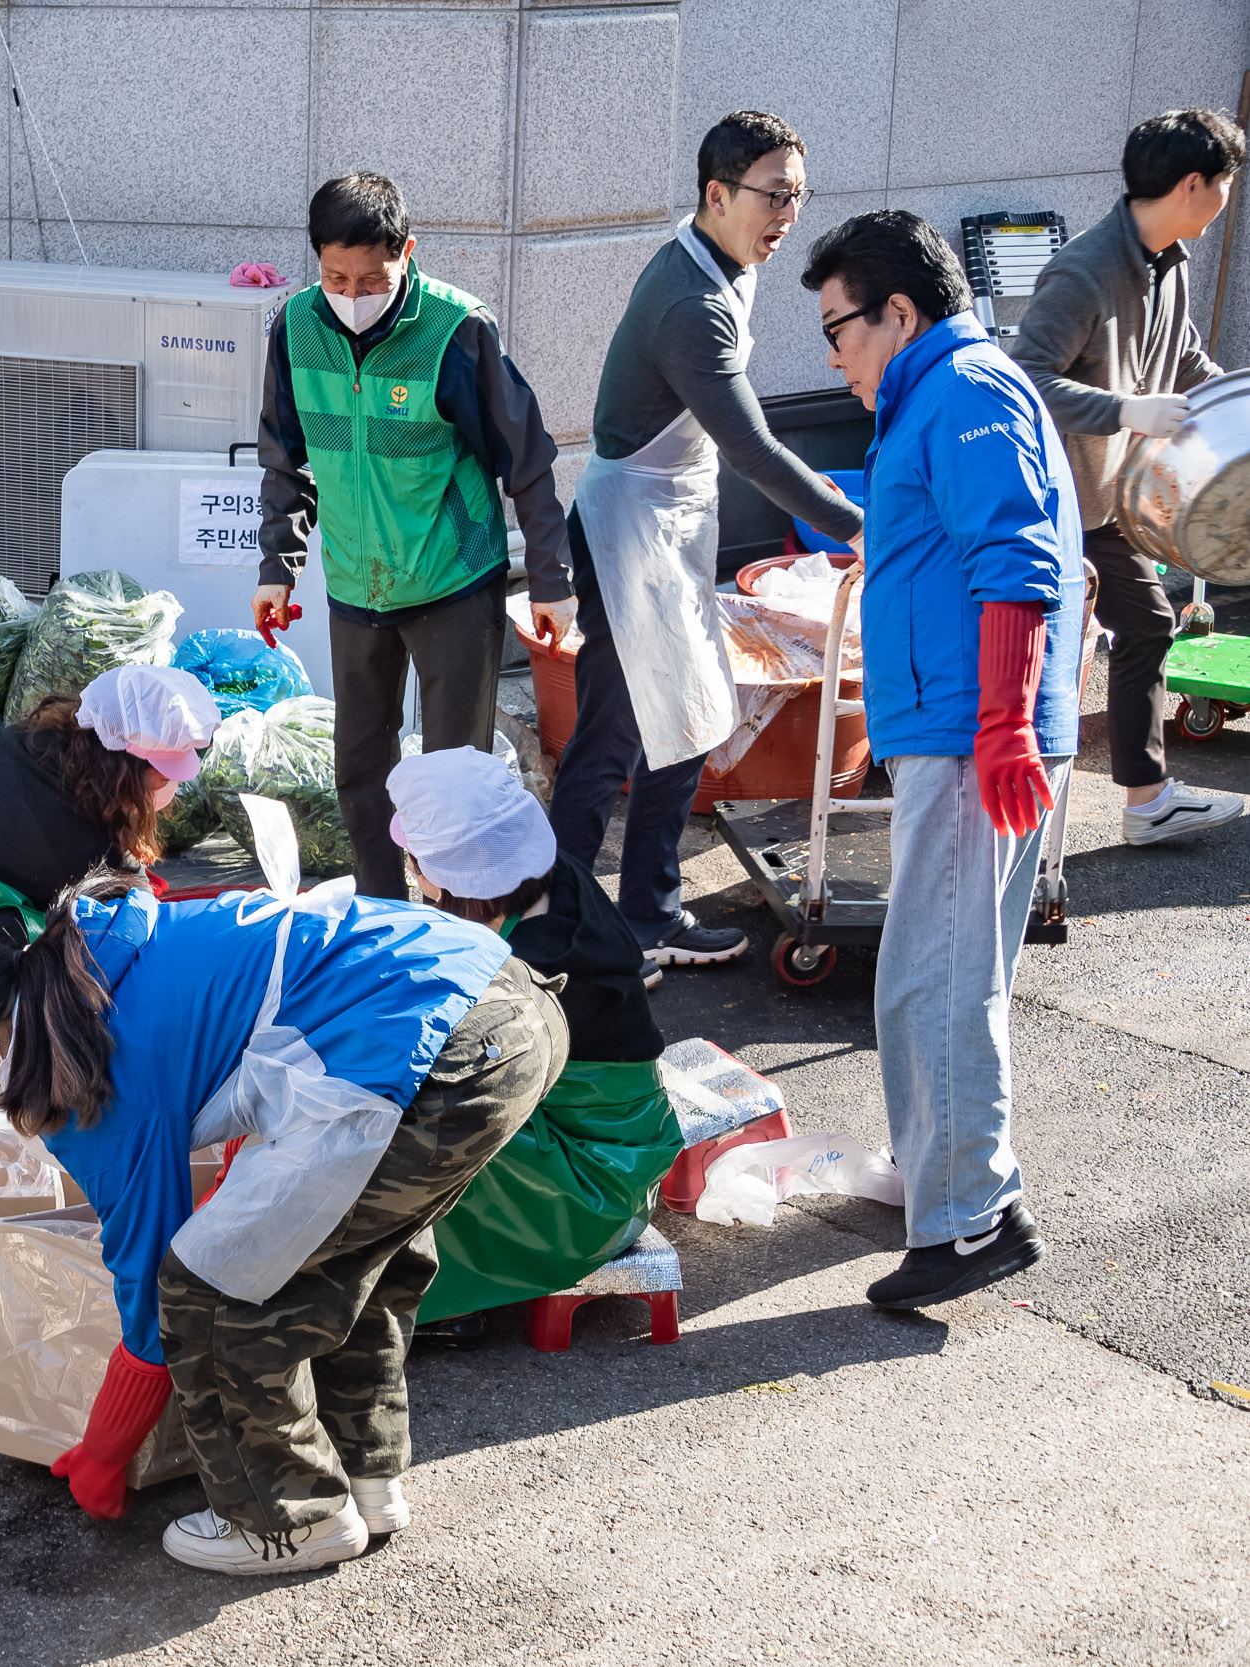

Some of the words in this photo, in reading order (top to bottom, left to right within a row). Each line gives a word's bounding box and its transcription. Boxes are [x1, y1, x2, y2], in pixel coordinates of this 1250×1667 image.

[161, 335, 235, 353] SAMSUNG
[384, 405, 409, 416] SMU
[958, 426, 990, 443] TEAM
[196, 529, 257, 549] 주민센
